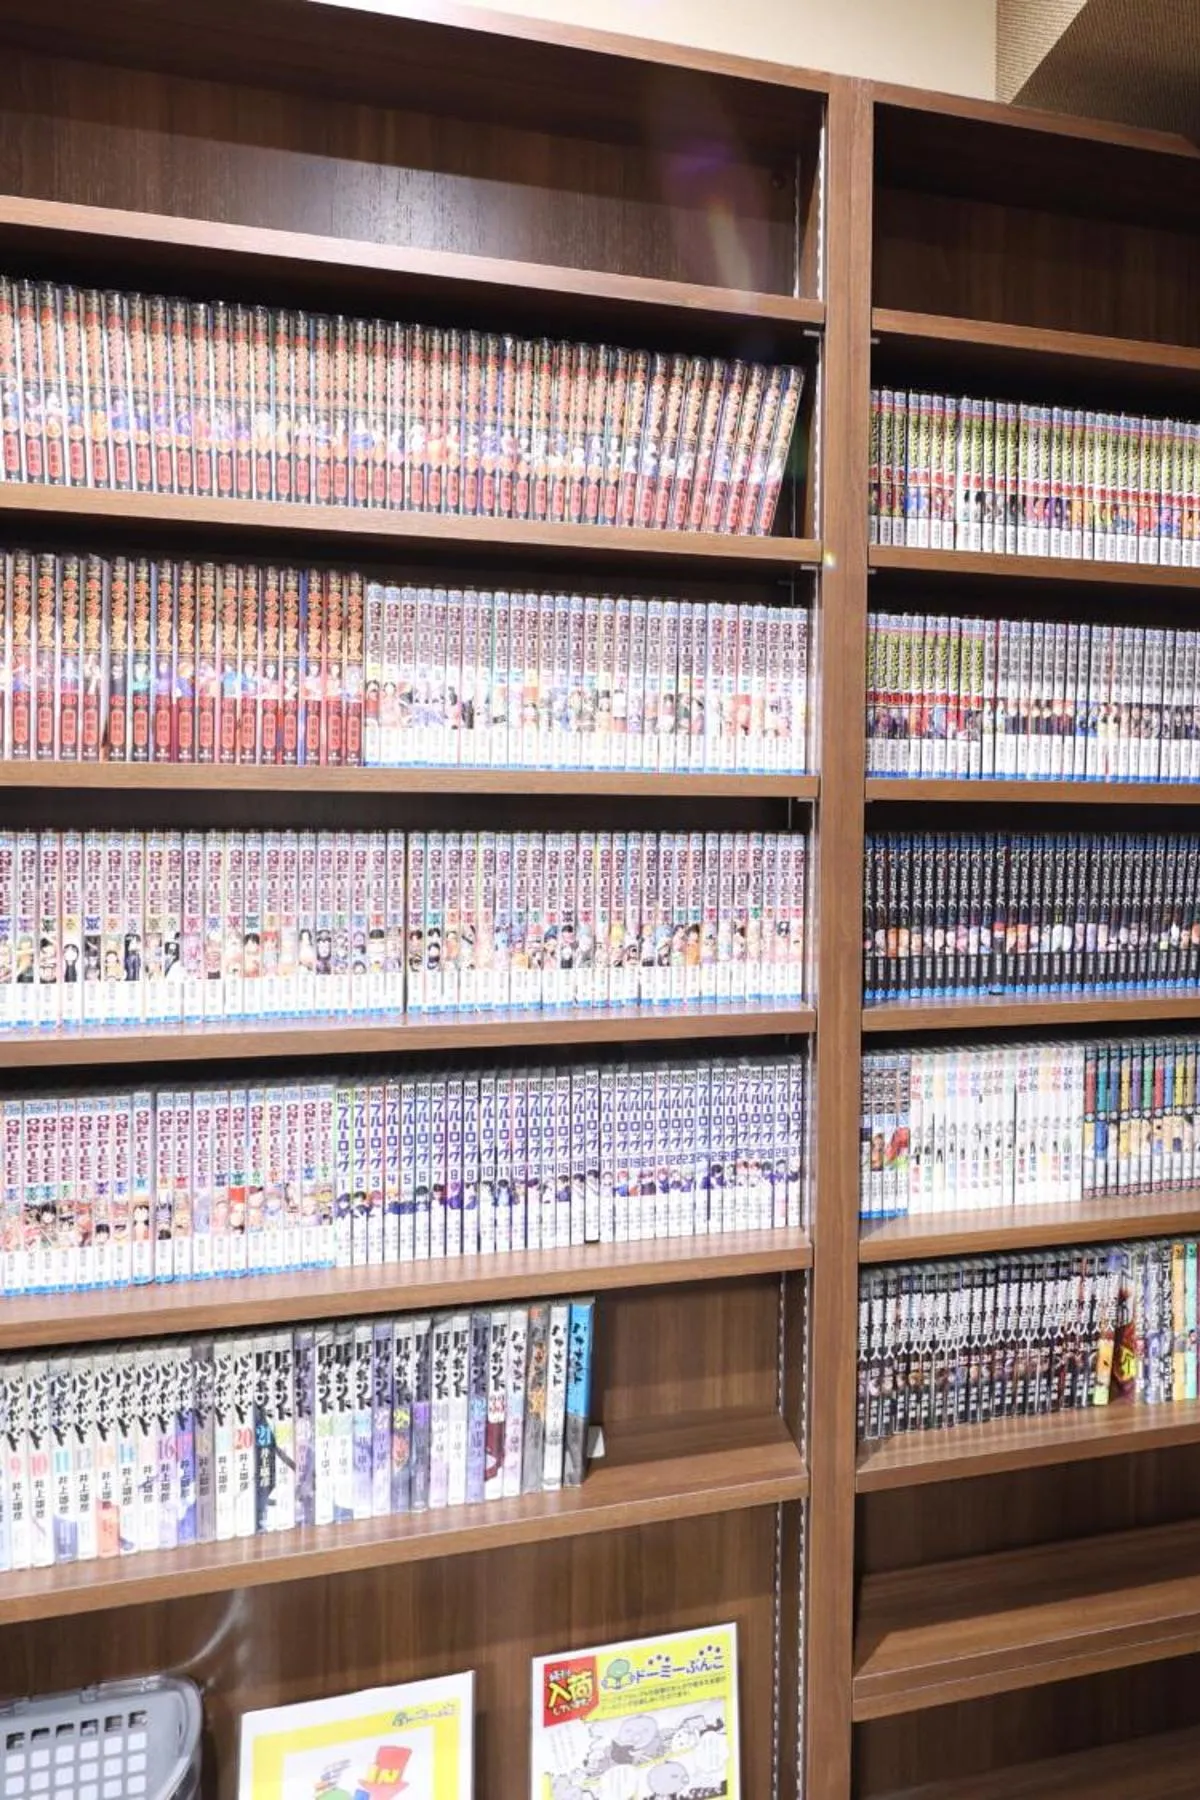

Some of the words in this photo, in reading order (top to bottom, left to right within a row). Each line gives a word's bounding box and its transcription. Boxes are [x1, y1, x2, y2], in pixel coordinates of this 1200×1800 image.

[451, 1170, 458, 1180] 8
[467, 1171, 474, 1181] 9
[482, 1166, 493, 1176] 10
[500, 1166, 509, 1177] 11
[515, 1166, 526, 1176] 12
[387, 1174, 395, 1184] 4
[404, 1174, 411, 1184] 5
[419, 1171, 426, 1182] 6
[434, 1172, 441, 1183] 7
[341, 1180, 345, 1189] 1
[356, 1178, 364, 1187] 2
[372, 1177, 380, 1187] 3
[549, 1671, 592, 1708] 入荷
